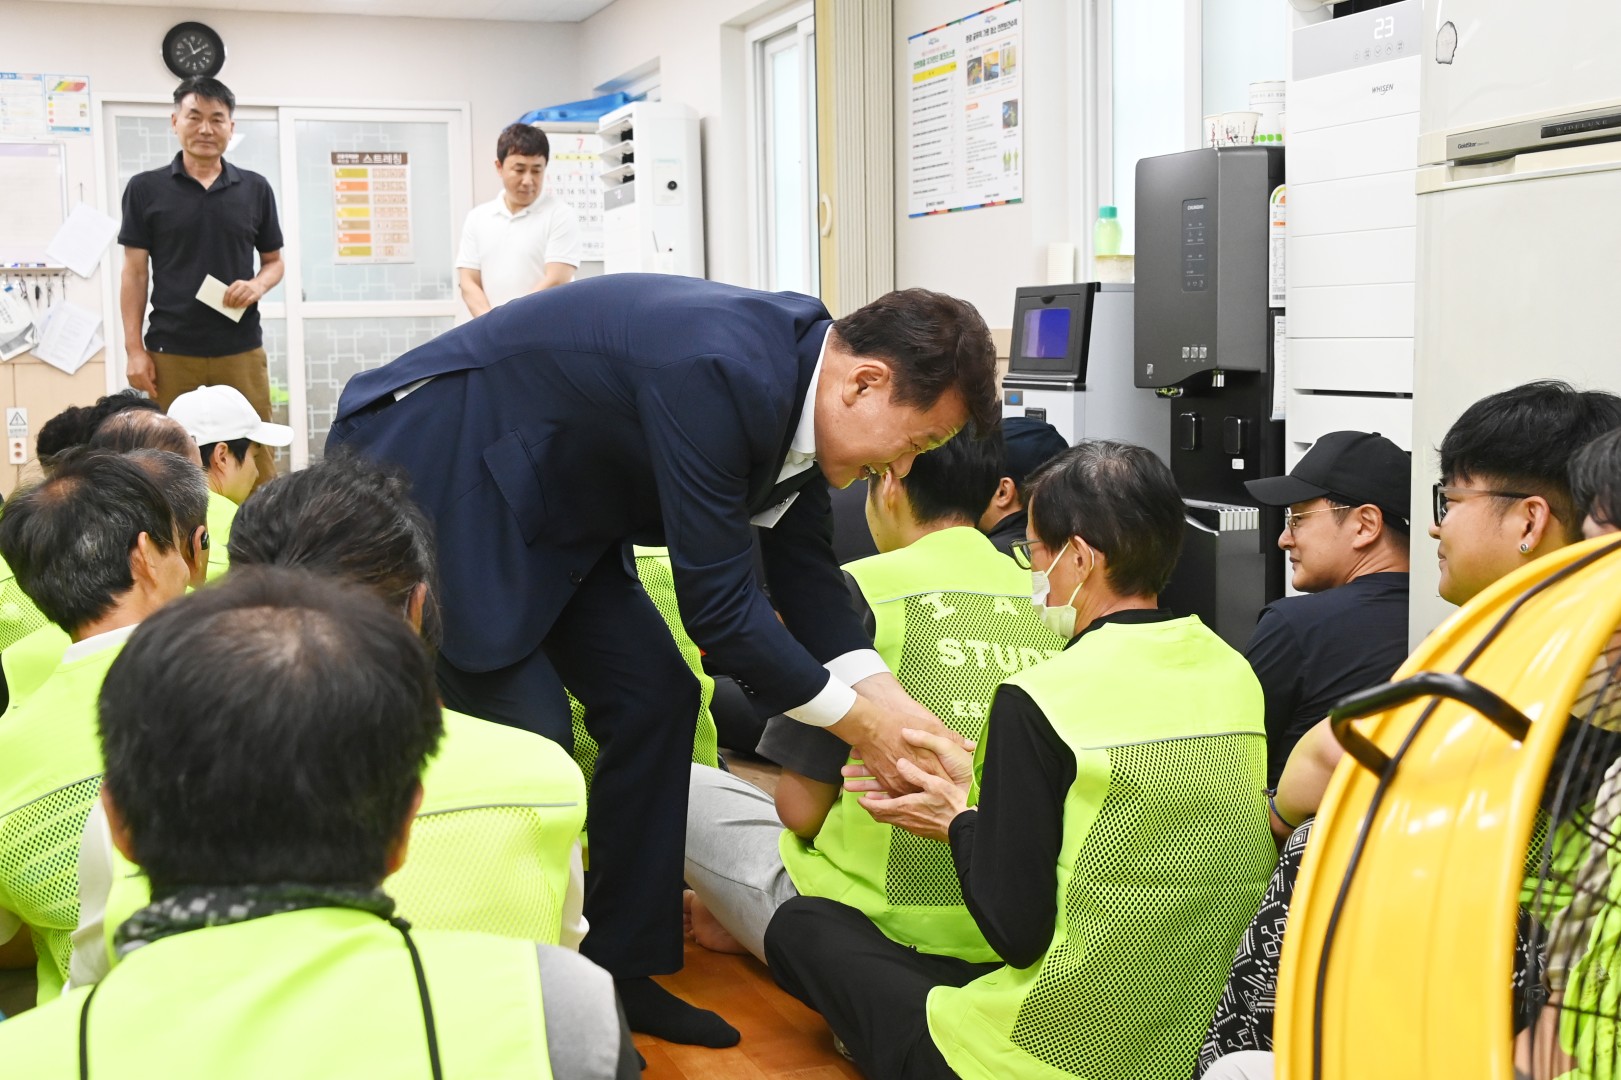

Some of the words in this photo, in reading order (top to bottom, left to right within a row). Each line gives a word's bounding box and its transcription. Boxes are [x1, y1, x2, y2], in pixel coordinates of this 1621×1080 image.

[1374, 16, 1394, 39] 23
[1371, 83, 1394, 95] WHISEN
[1556, 119, 1608, 132] WIDELUXE
[576, 138, 584, 150] 7
[1457, 141, 1477, 150] GoldStar
[362, 153, 402, 165] 스트레칭
[937, 637, 1064, 674] STUD
[953, 700, 990, 717] ES
